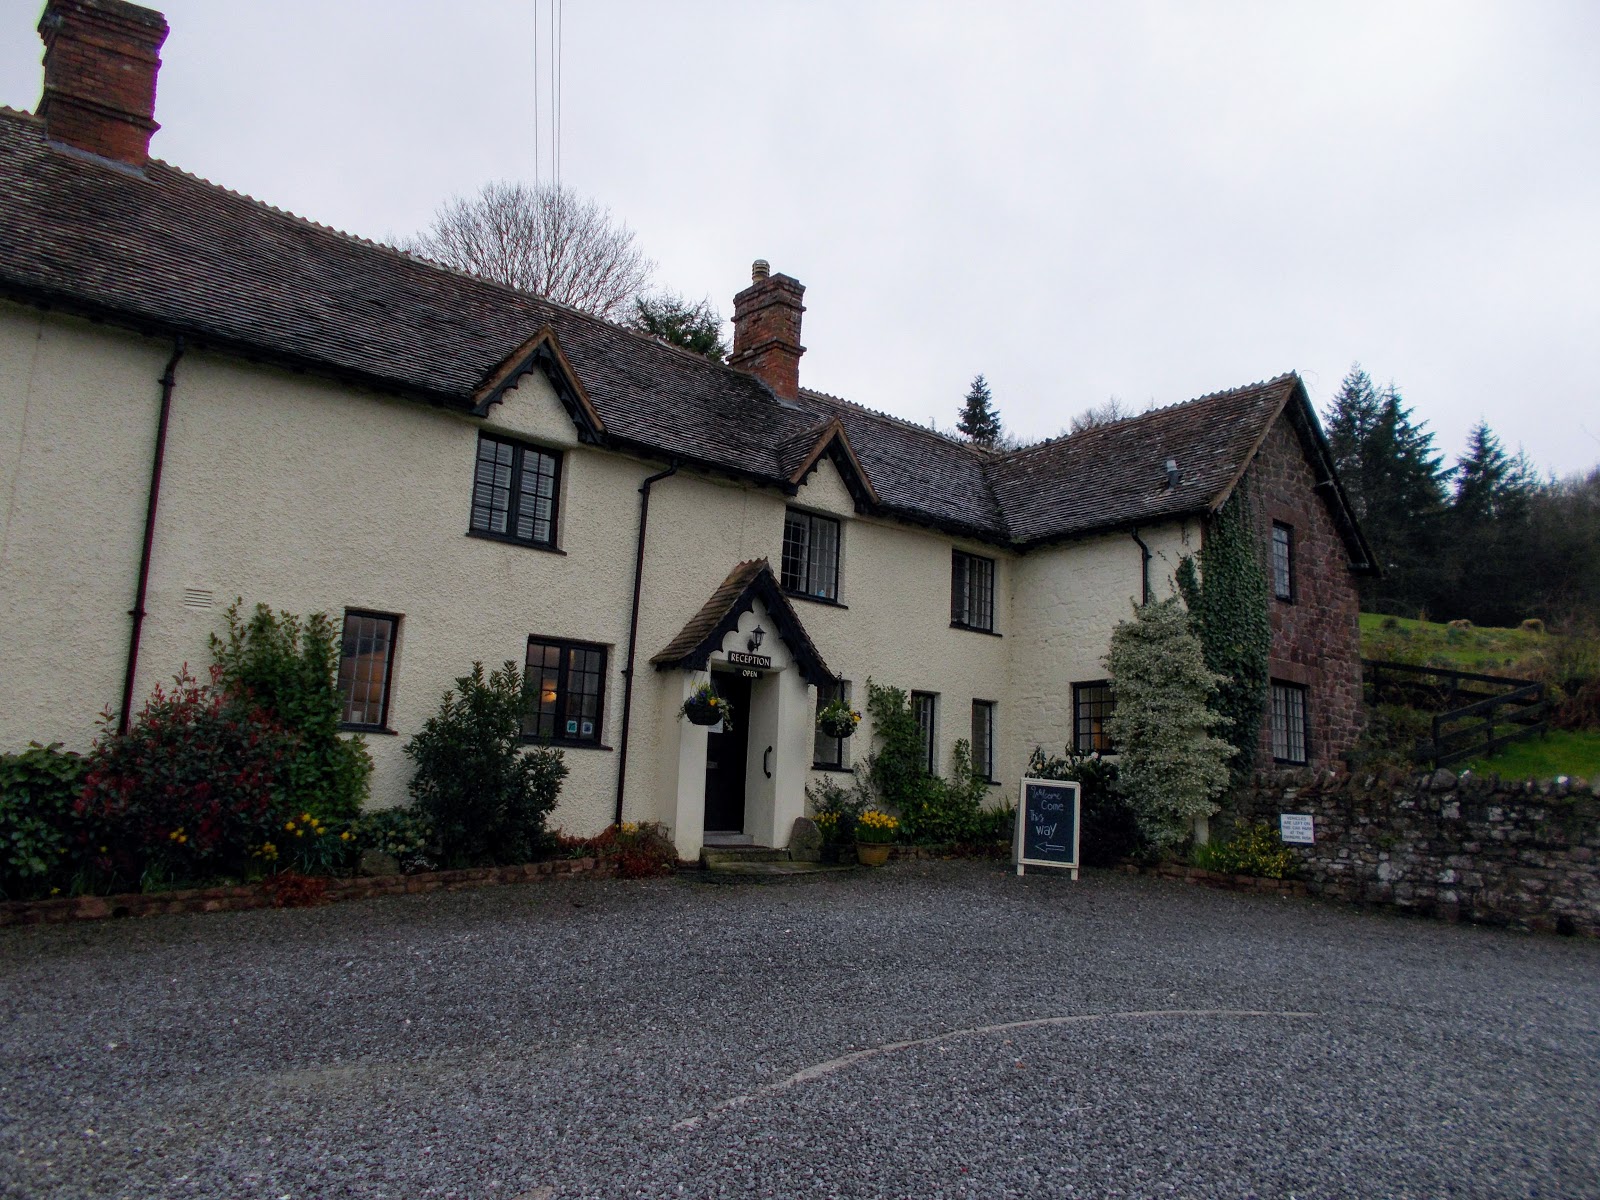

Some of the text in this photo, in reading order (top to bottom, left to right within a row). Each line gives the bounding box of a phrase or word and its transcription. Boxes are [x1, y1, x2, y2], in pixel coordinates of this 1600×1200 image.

[731, 653, 770, 667] RECEPTION
[742, 669, 758, 678] OPEN
[1041, 799, 1064, 811] Come
[1029, 809, 1044, 822] This
